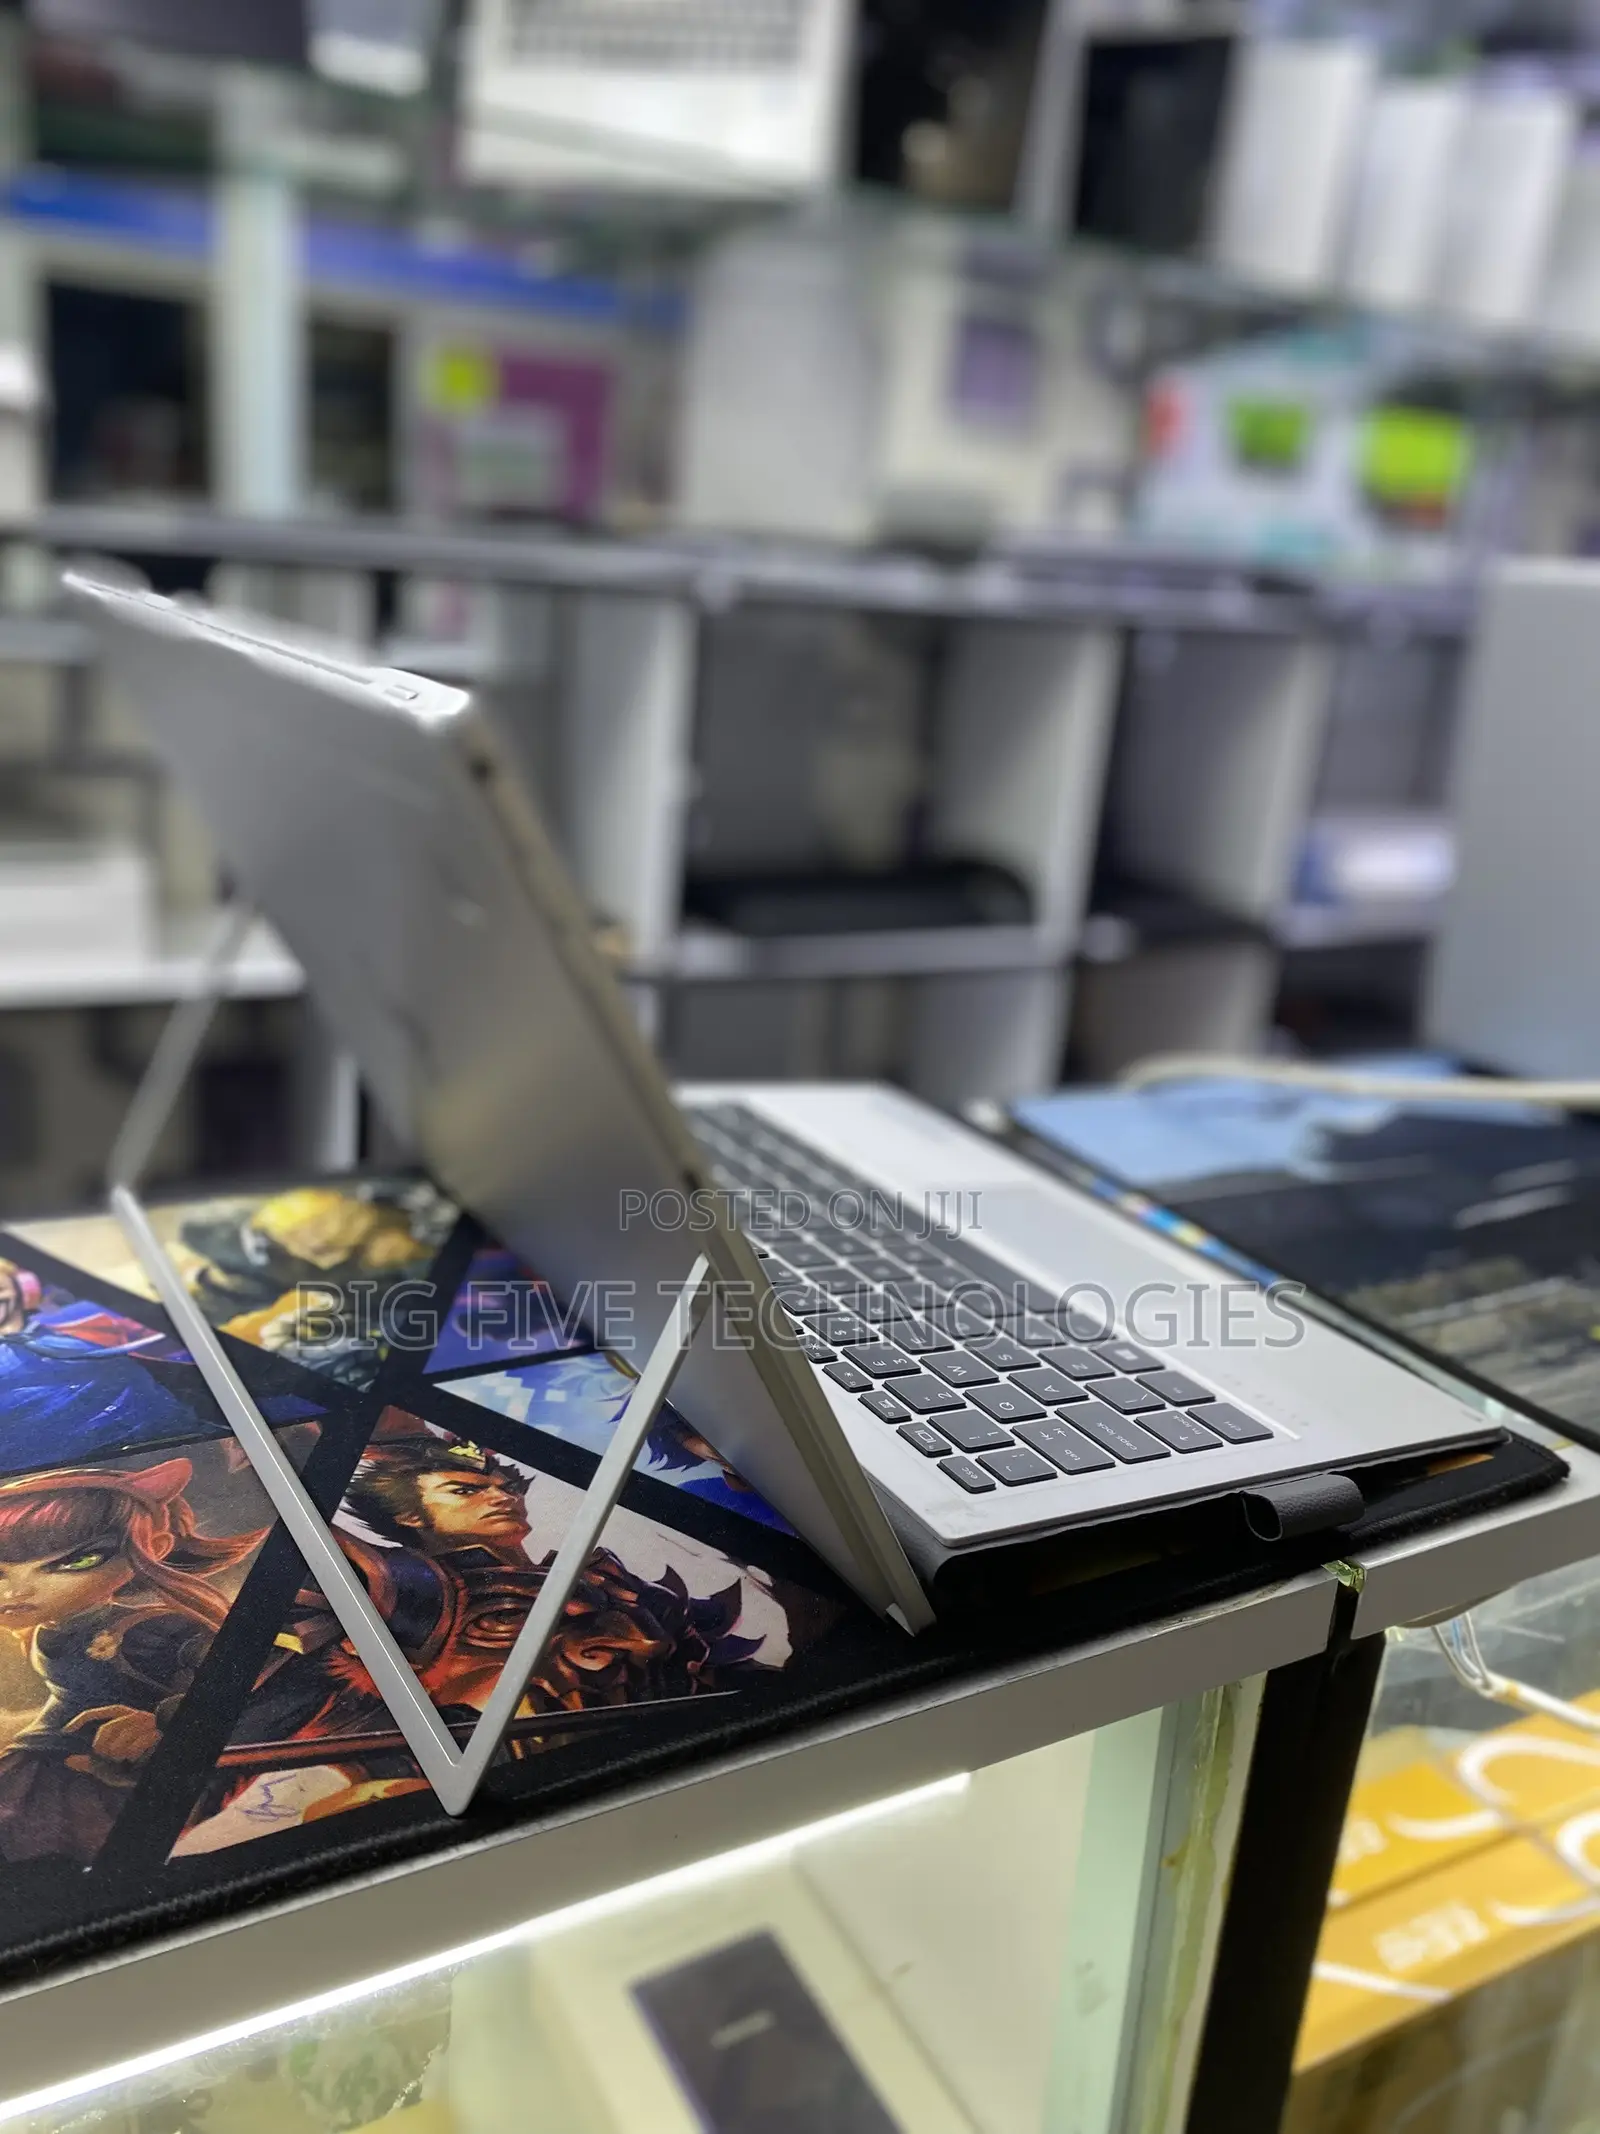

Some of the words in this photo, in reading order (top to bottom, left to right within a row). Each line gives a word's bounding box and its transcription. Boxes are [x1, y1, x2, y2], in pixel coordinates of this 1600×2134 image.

[998, 1353, 1013, 1361] S
[946, 1364, 967, 1376] W
[1071, 1362, 1089, 1371] Z
[1044, 1384, 1060, 1393] A
[937, 1391, 953, 1399] 2
[999, 1401, 1015, 1411] Q
[1096, 1421, 1117, 1436] lock
[1115, 1435, 1138, 1451] caps
[1064, 1449, 1081, 1461] tab
[961, 1466, 979, 1479] esc
